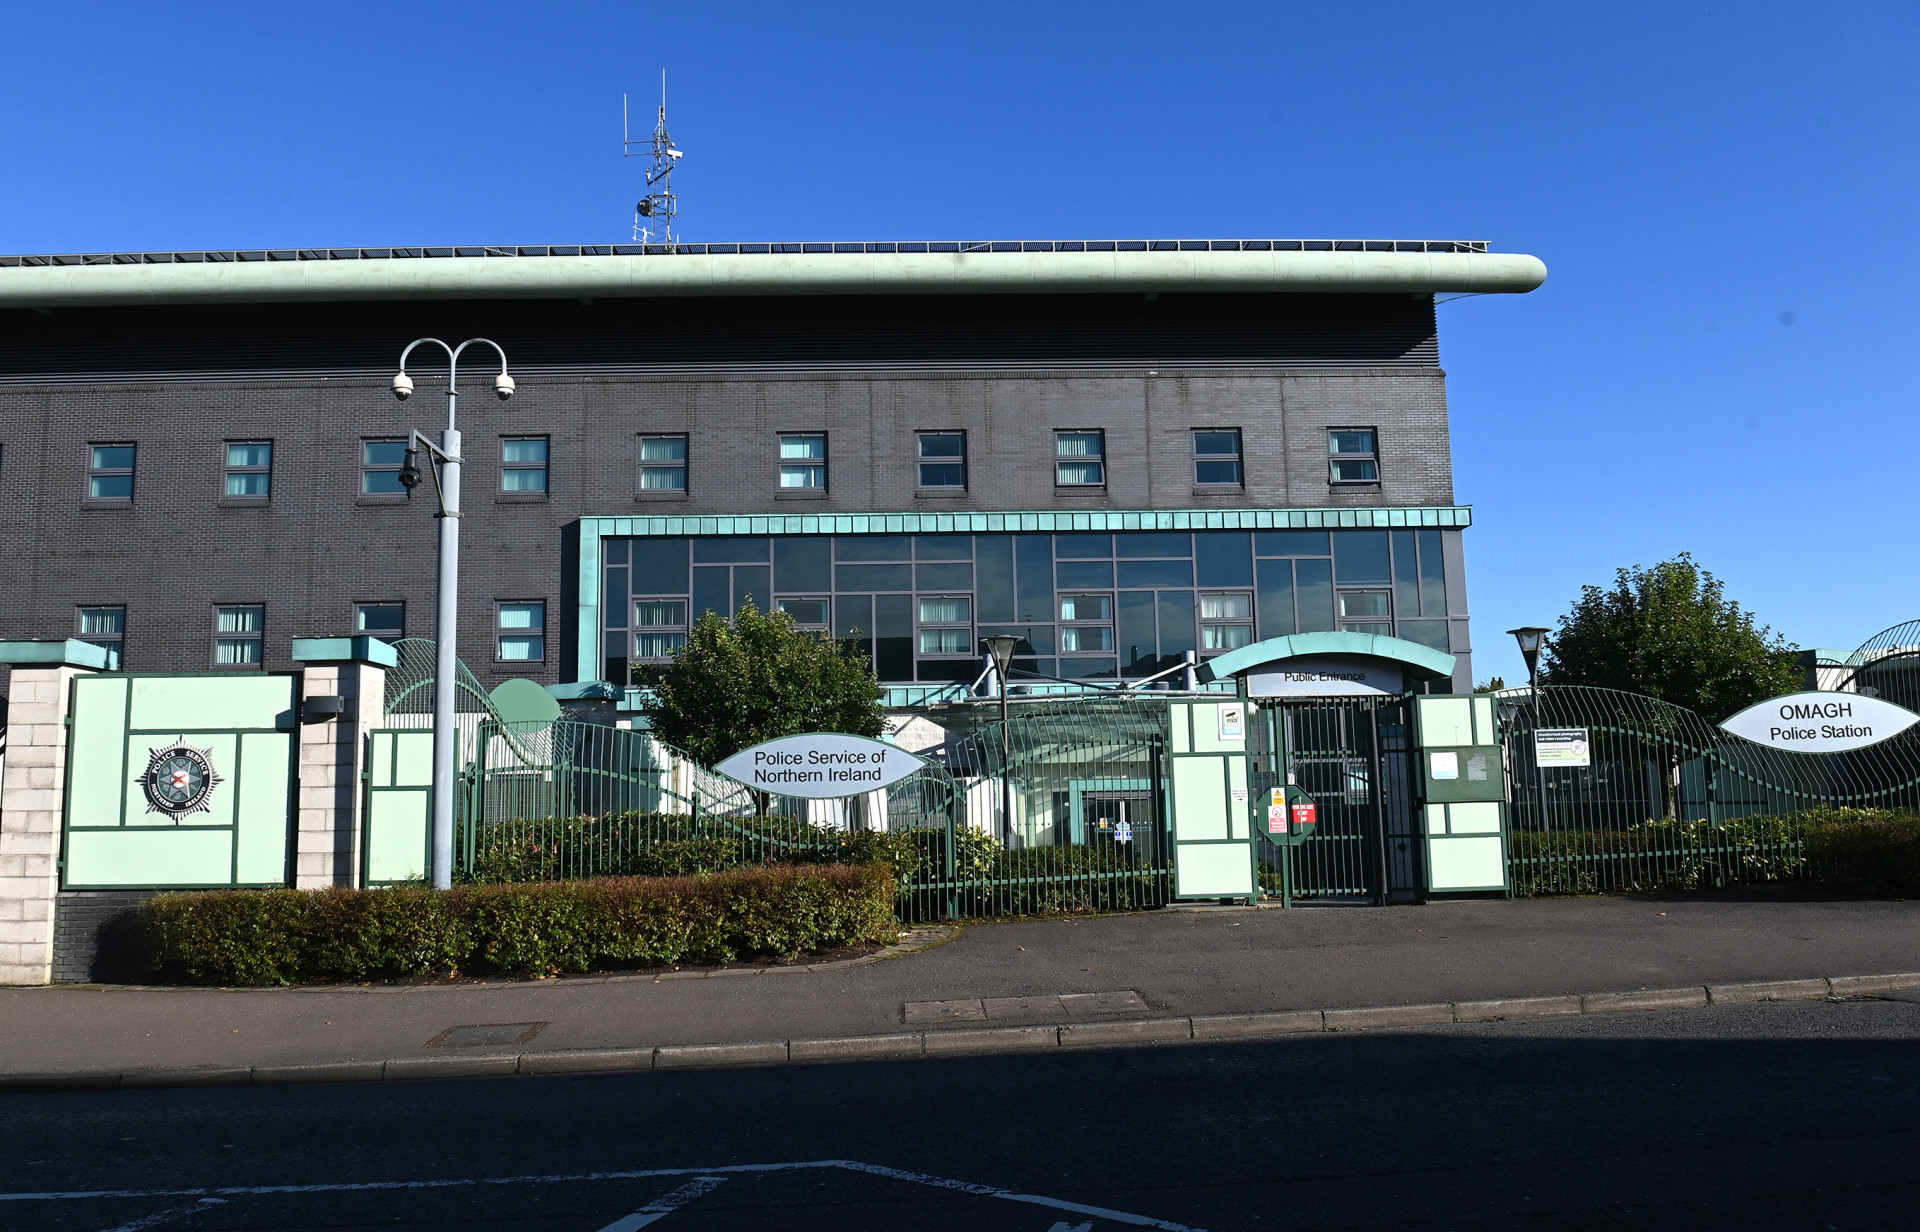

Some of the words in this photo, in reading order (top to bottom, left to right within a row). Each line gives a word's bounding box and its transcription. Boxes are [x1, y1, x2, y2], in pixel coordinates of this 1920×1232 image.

[1284, 672, 1317, 682] Public
[1319, 672, 1366, 682] Entrance
[1780, 702, 1852, 720] OMAGH
[1770, 727, 1816, 741] Police
[1821, 724, 1872, 739] Station
[152, 751, 176, 774] POLICE
[185, 751, 208, 775] SERVICE
[755, 751, 803, 766] Police
[808, 750, 867, 765] Service
[871, 749, 886, 763] of
[754, 769, 823, 783] Northern
[829, 767, 881, 782] Ireland
[151, 783, 174, 808] NORTHERN
[185, 786, 206, 807] IRELAND
